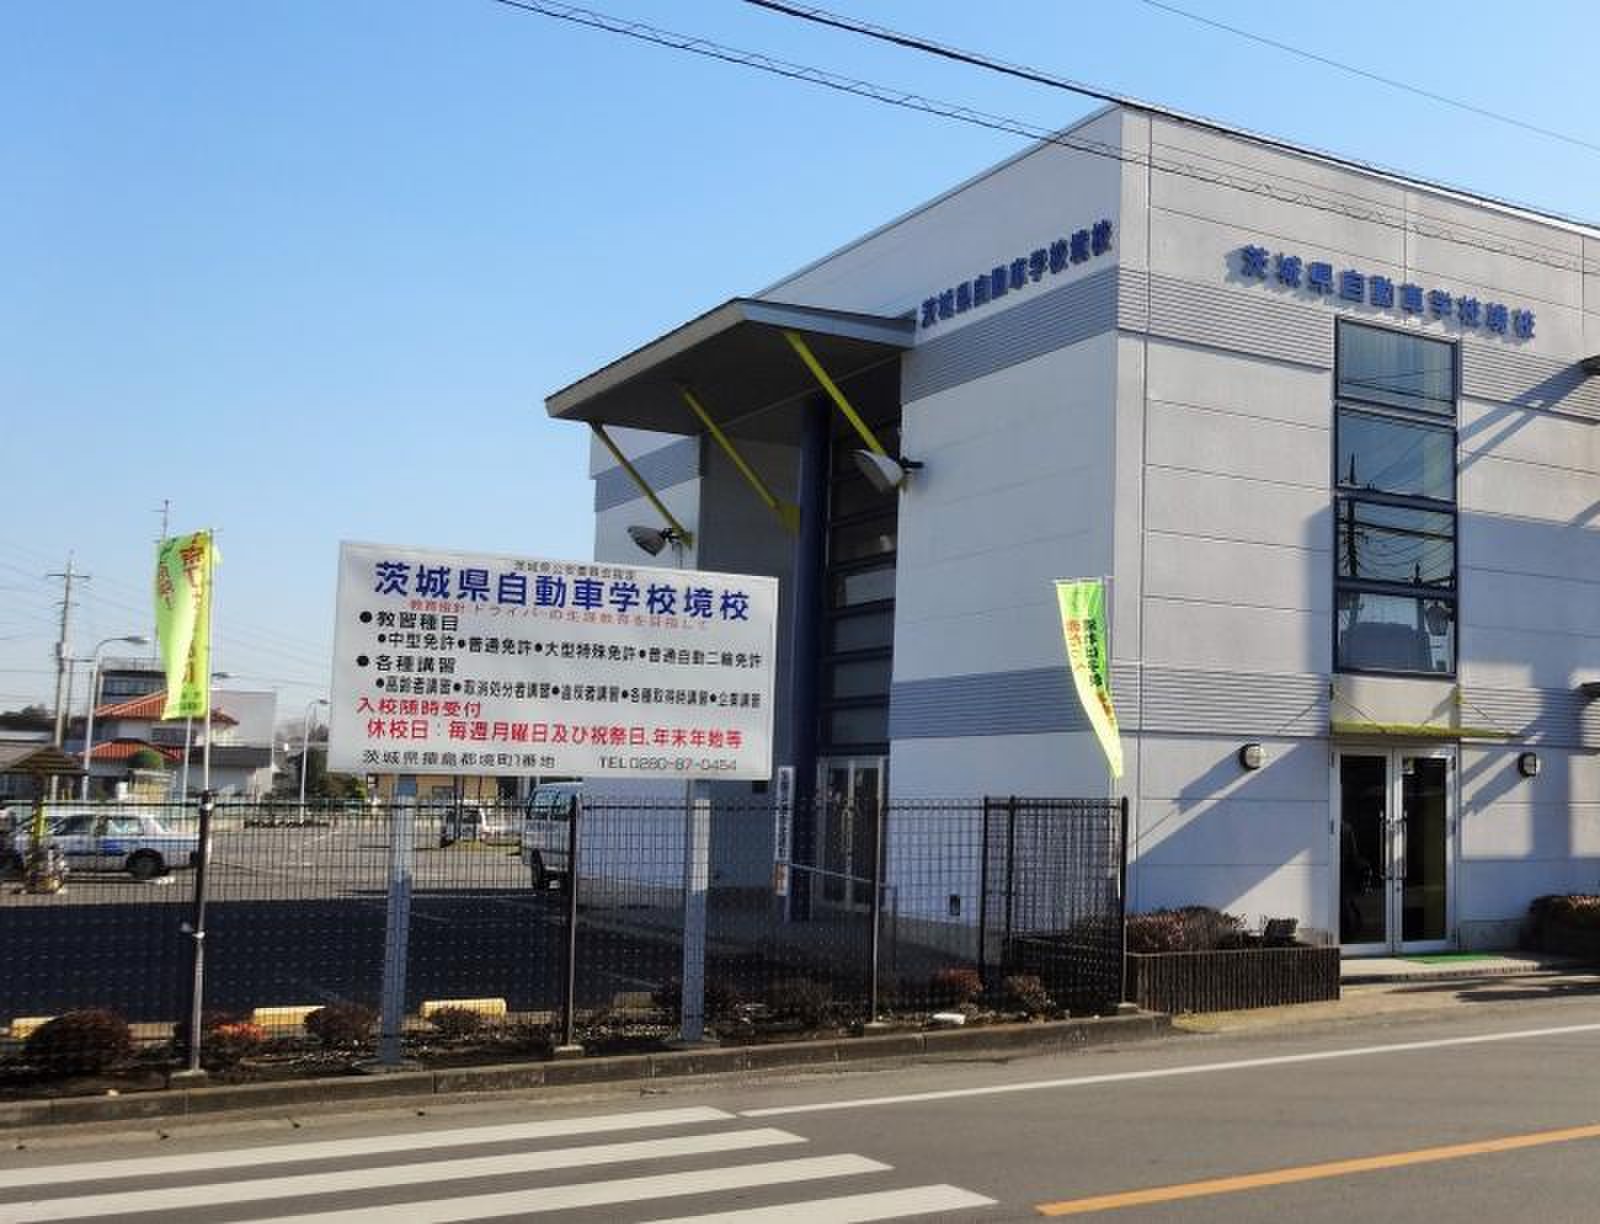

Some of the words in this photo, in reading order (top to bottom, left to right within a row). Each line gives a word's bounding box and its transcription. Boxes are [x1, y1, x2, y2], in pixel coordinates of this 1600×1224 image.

[1240, 244, 1535, 340] 茨城県自動車学校境校
[375, 561, 749, 621] 茨城県自動車学校境校
[377, 611, 458, 631] 教習種目
[376, 654, 455, 673] 各種講習
[388, 633, 455, 650] 中型免許
[469, 637, 532, 655] 普通免許
[546, 642, 636, 660] 大型特殊免許
[649, 647, 761, 668] 普通自動二輪免許
[356, 697, 481, 718] 入校随時受付
